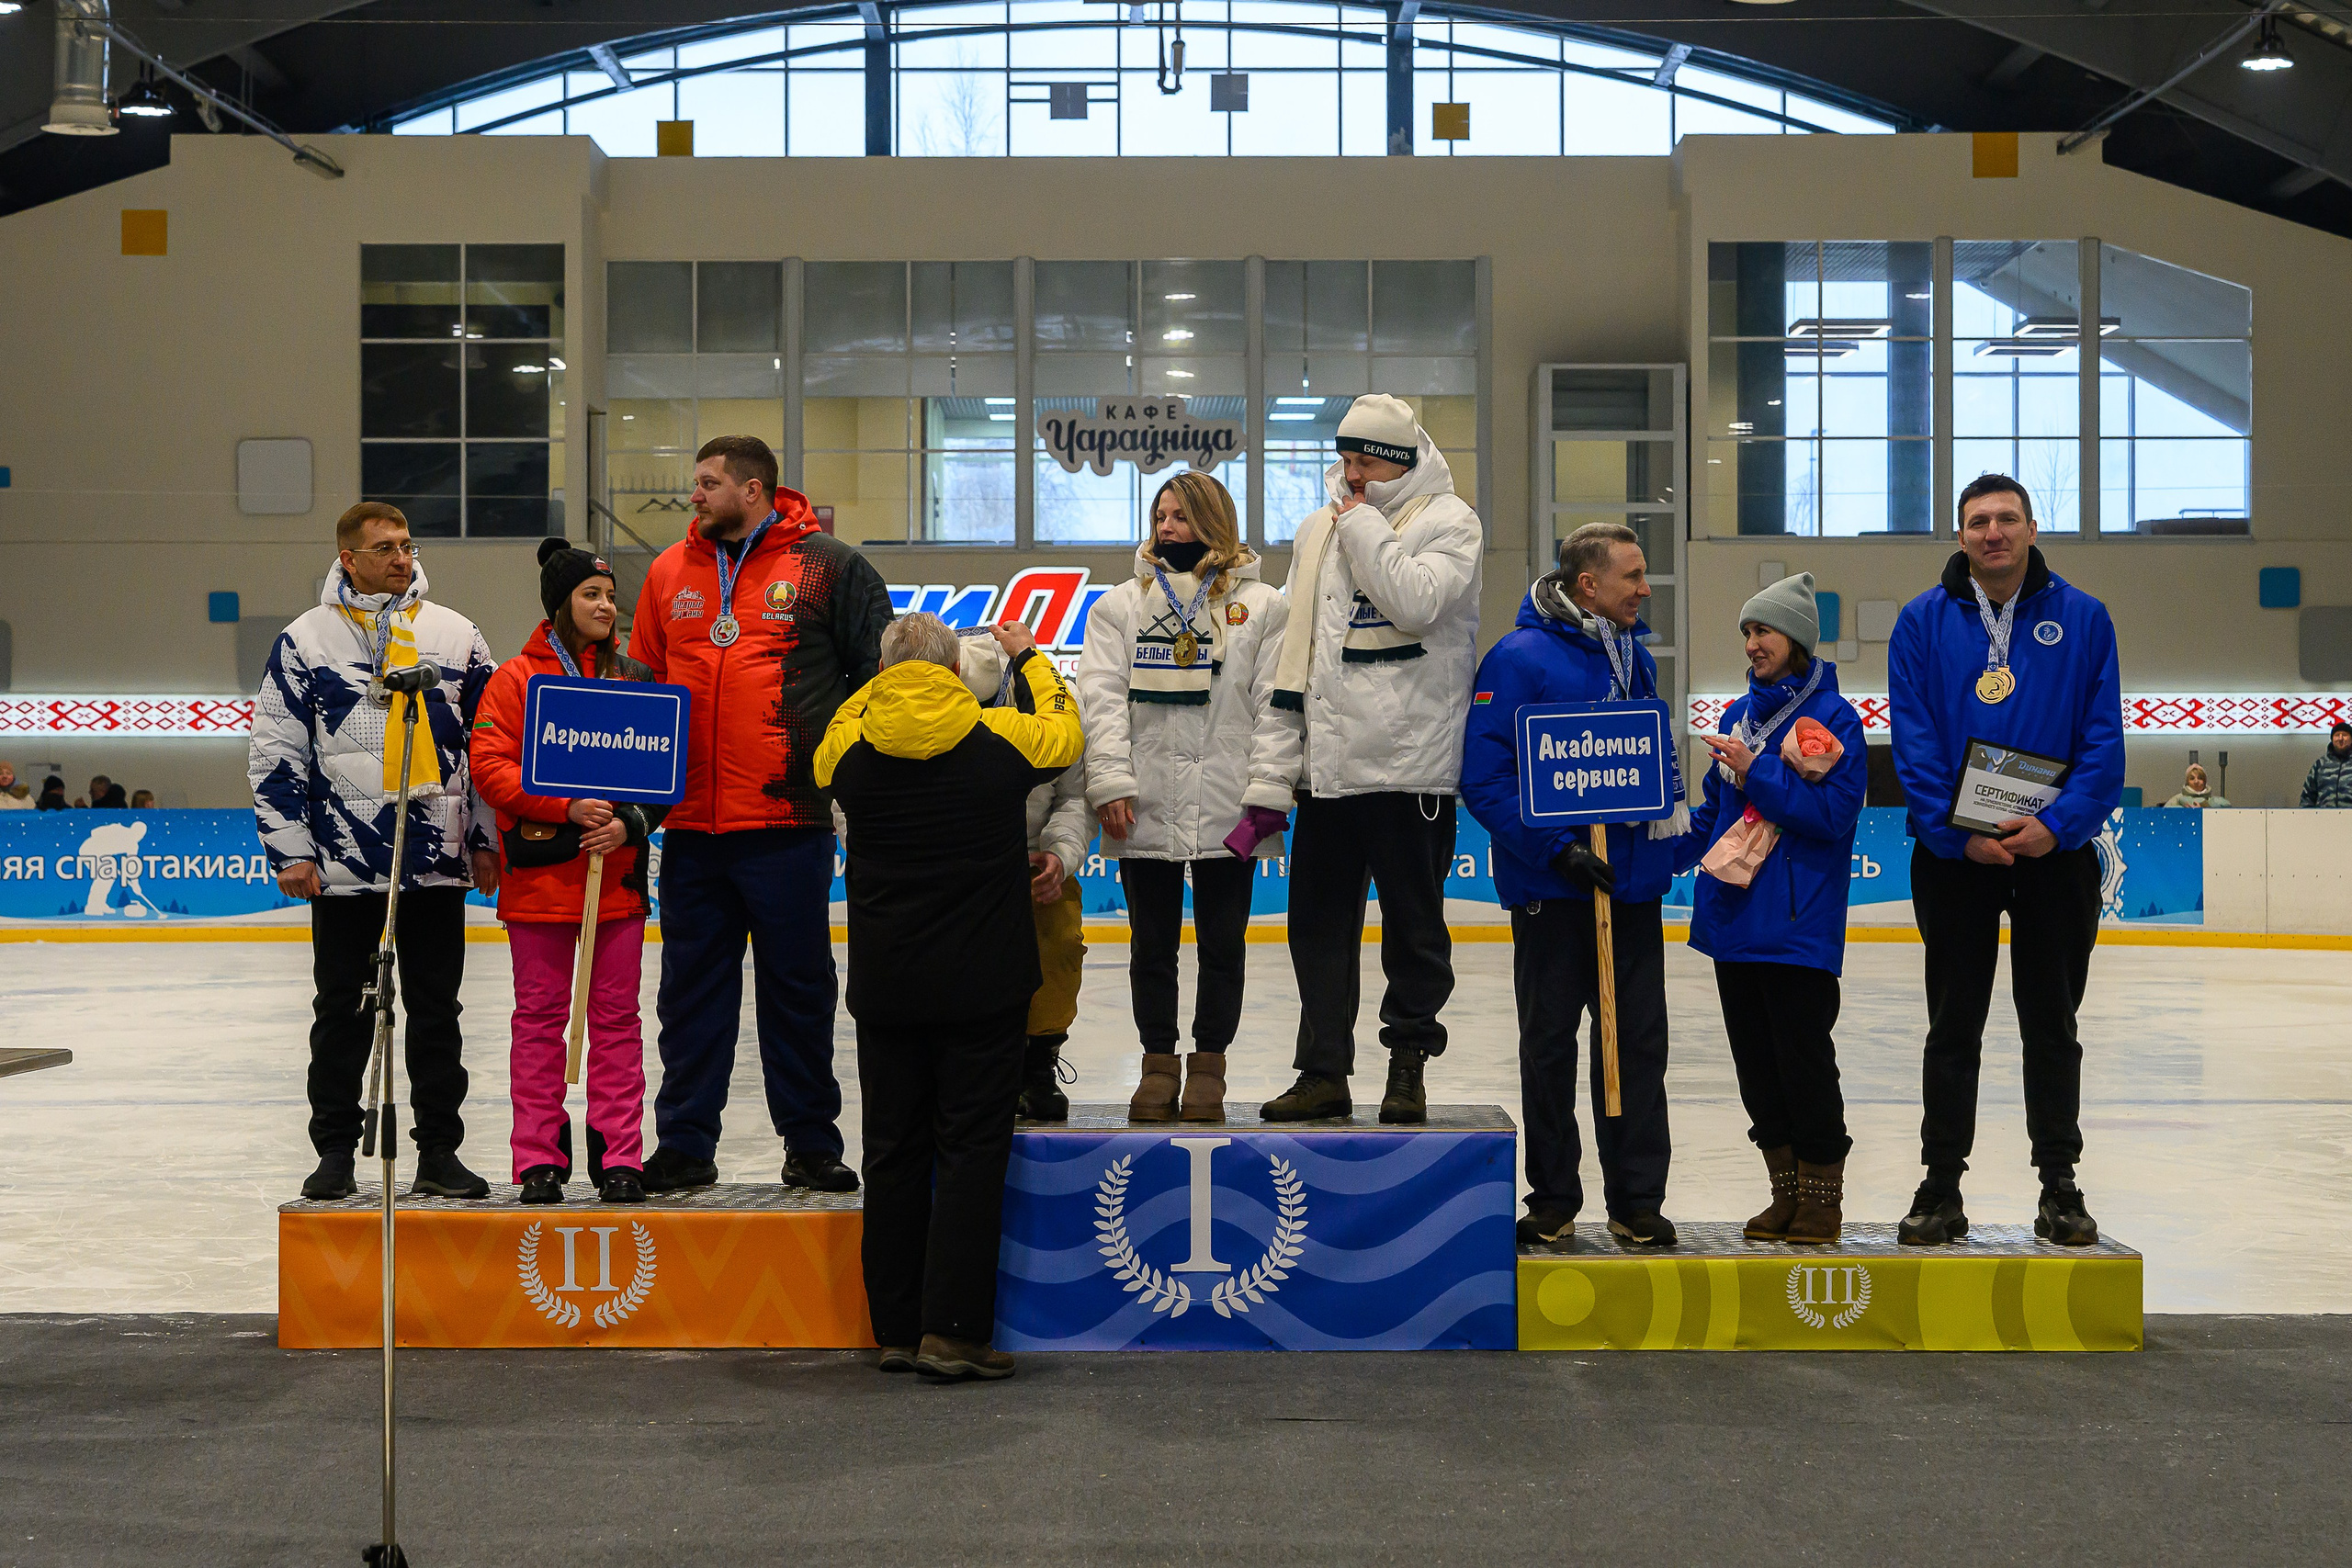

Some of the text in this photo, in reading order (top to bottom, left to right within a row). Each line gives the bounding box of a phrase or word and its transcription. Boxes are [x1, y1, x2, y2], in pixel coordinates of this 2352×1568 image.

[1105, 405, 1177, 420] КАФЕ
[1046, 419, 1238, 468] Чараўніца
[1363, 444, 1410, 460] БЕЛАРУСЬ
[761, 612, 794, 622] BELARUS
[1136, 647, 1172, 660] БЕЛЫЕ
[542, 721, 671, 752] Агрохолдинг
[1538, 729, 1652, 761] Академия
[1553, 767, 1641, 797] сервиса
[1974, 784, 2045, 809] СЕРТИФИКАТ
[1170, 1137, 1232, 1272] I
[554, 1227, 620, 1292] II
[1801, 1267, 1859, 1304] III
